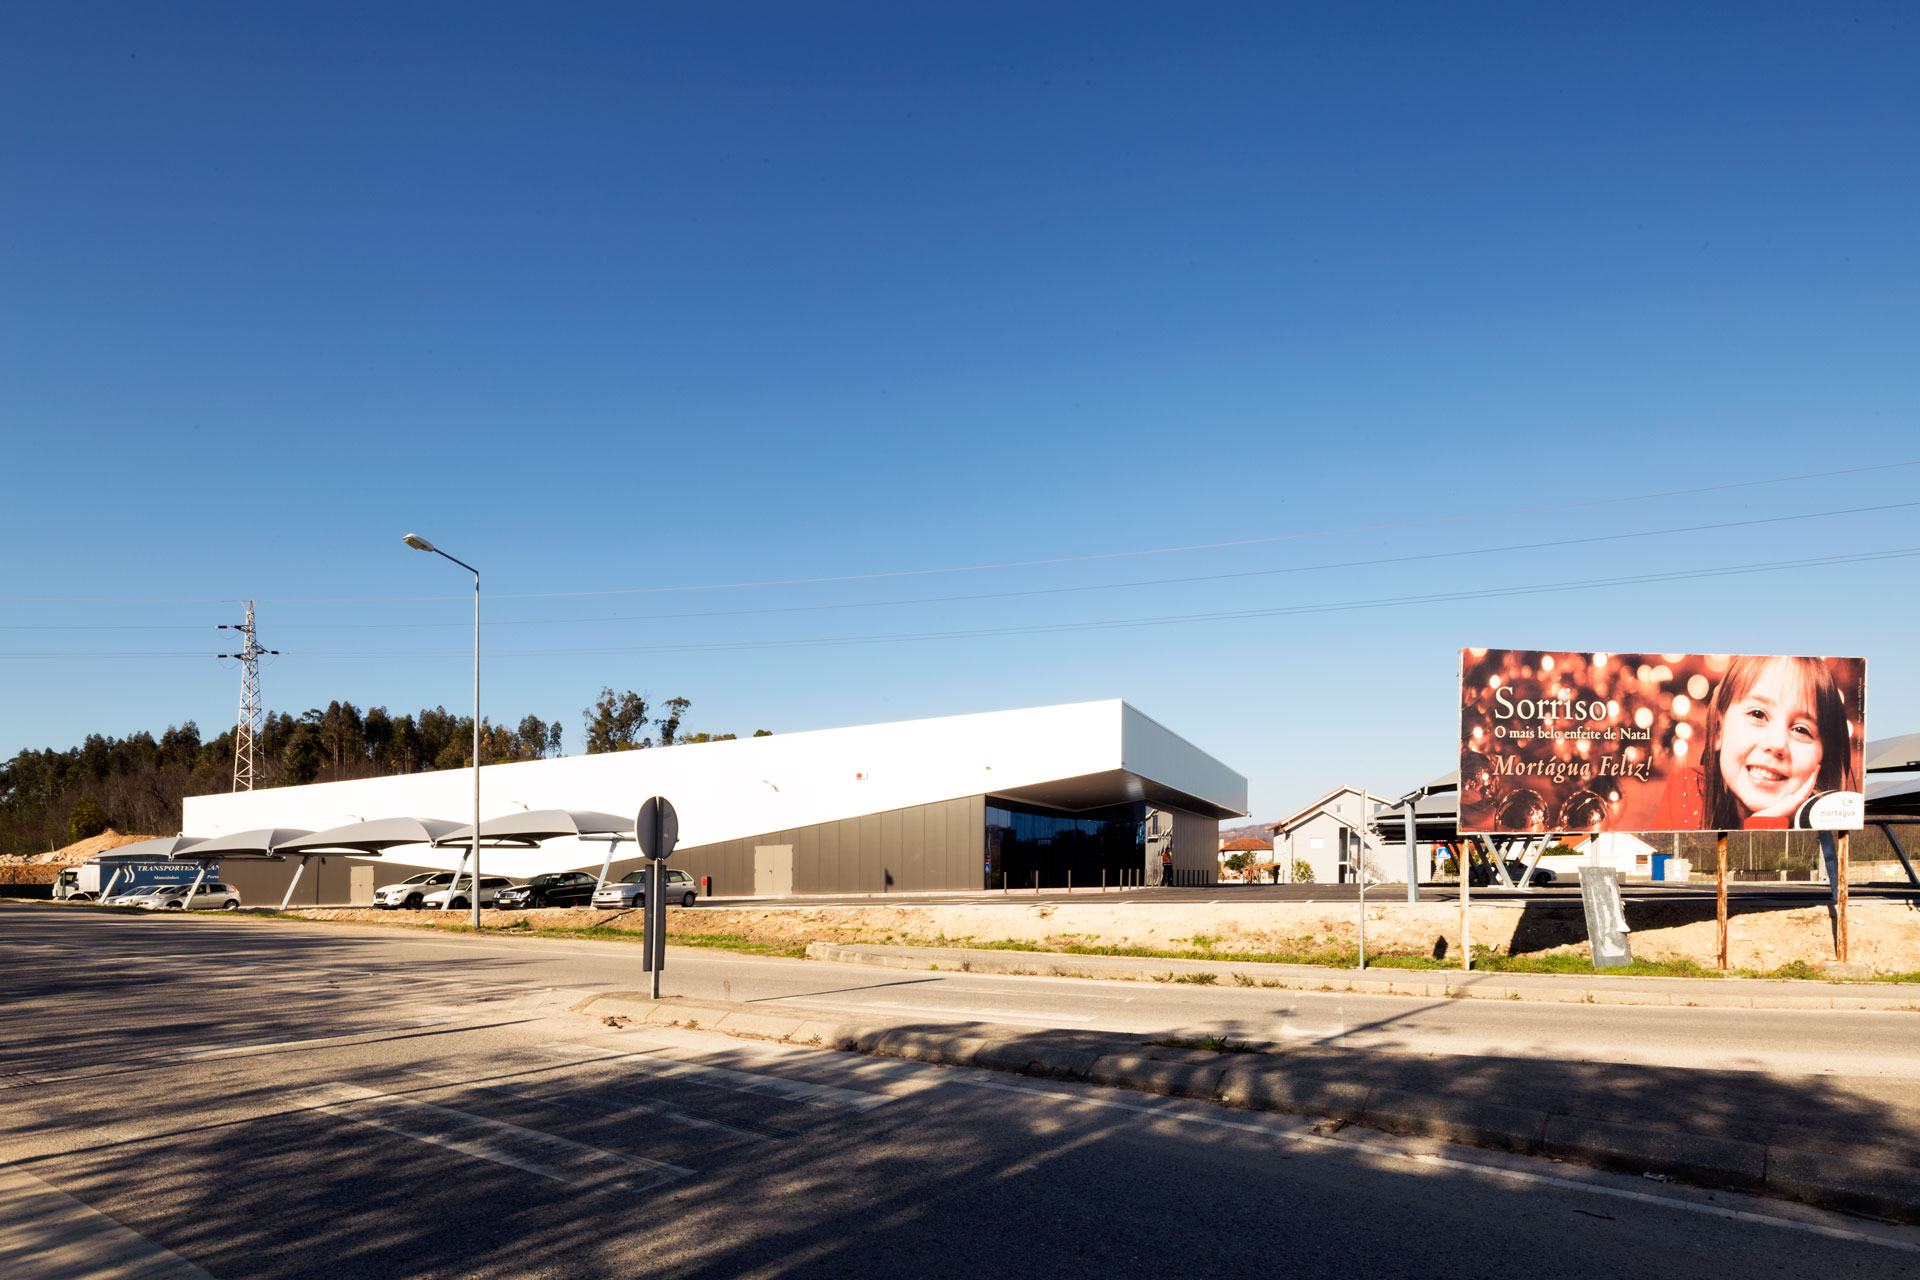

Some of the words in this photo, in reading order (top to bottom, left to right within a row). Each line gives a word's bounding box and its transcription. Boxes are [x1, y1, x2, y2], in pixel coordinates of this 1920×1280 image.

[1494, 686, 1607, 721] Sorriso
[1494, 725, 1506, 739] O
[1509, 725, 1535, 739] mais
[1538, 725, 1562, 740] belo
[1564, 726, 1601, 740] enfeite
[1603, 727, 1617, 740] de
[1620, 727, 1651, 740] Natal
[1491, 754, 1591, 784] Mortágua
[1597, 753, 1653, 782] Feliz!
